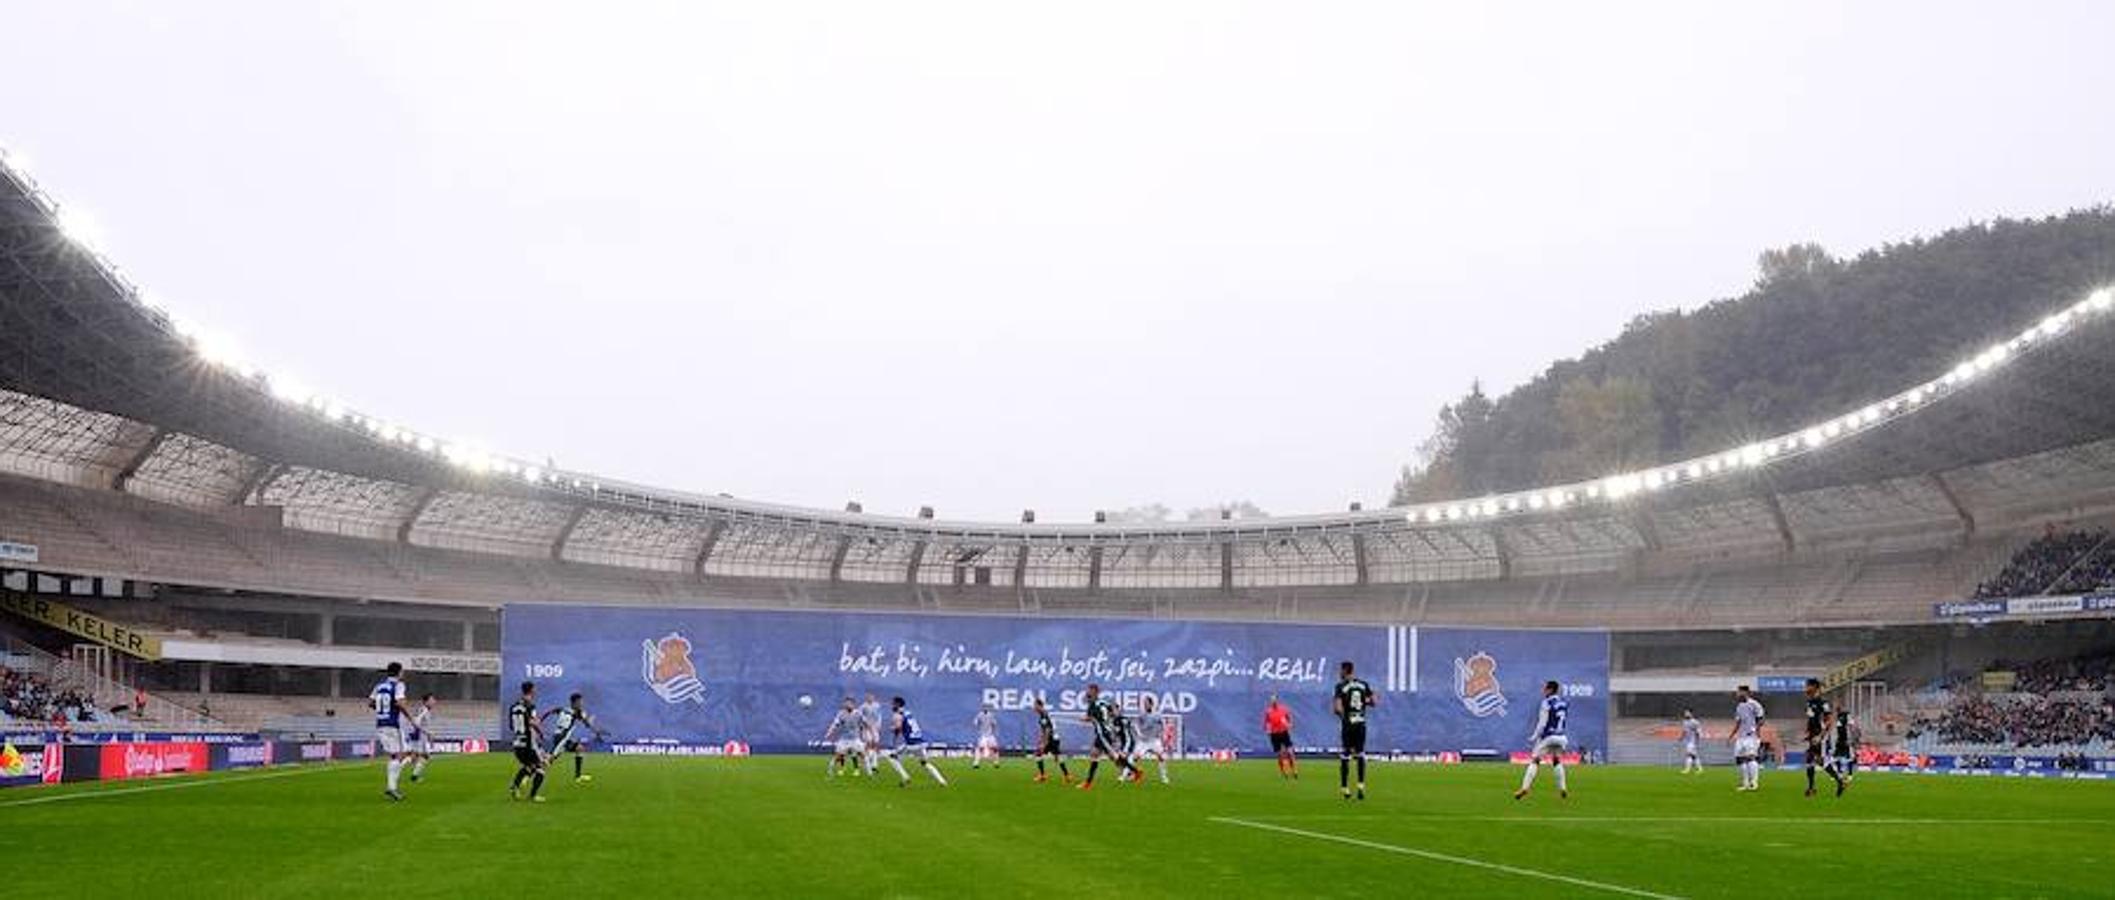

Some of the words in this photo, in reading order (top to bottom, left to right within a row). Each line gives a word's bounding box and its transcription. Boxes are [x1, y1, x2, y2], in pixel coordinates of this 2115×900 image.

[525, 664, 563, 678] 1909
[839, 642, 890, 678] bat,
[897, 643, 928, 678] bi,
[937, 644, 999, 678] hiru,
[1060, 646, 1112, 681] bost,
[1115, 650, 1155, 682] sei,
[1258, 656, 1327, 683] REAL!
[983, 688, 1053, 711] REAL
